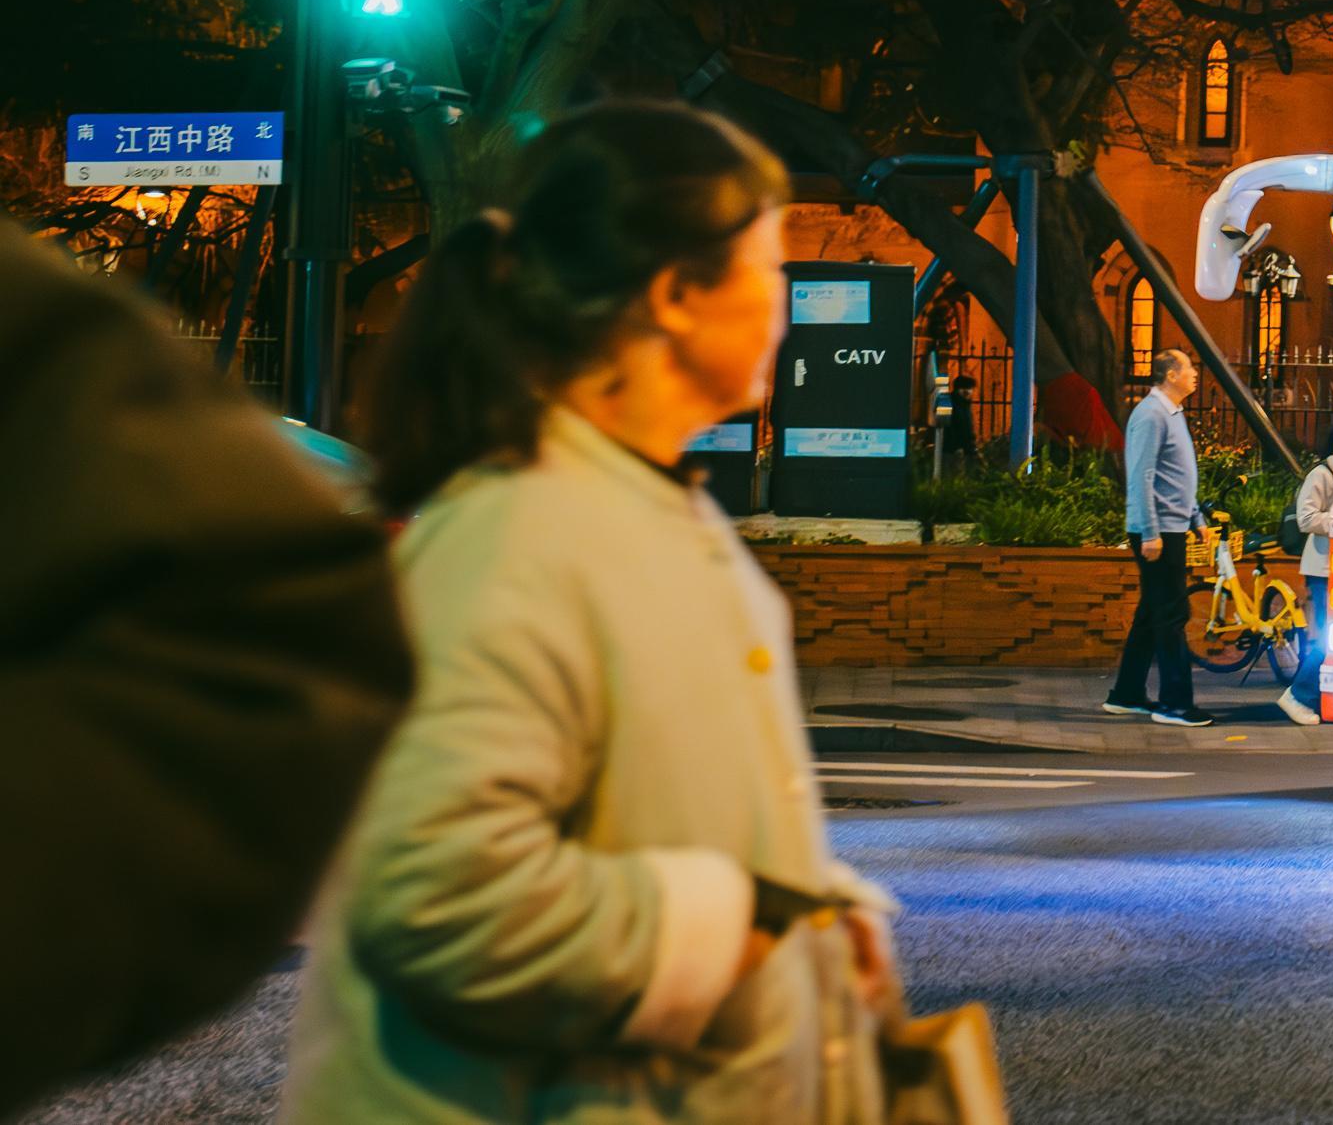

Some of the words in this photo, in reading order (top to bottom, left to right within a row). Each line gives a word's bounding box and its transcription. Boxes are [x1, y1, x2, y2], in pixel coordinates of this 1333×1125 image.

[77, 124, 95, 141] 南
[115, 124, 234, 154] 江西中路
[255, 121, 273, 139] 北
[78, 166, 90, 181] S
[124, 166, 169, 180] Jiangxi
[257, 166, 269, 178] N
[834, 349, 886, 365] CATV
